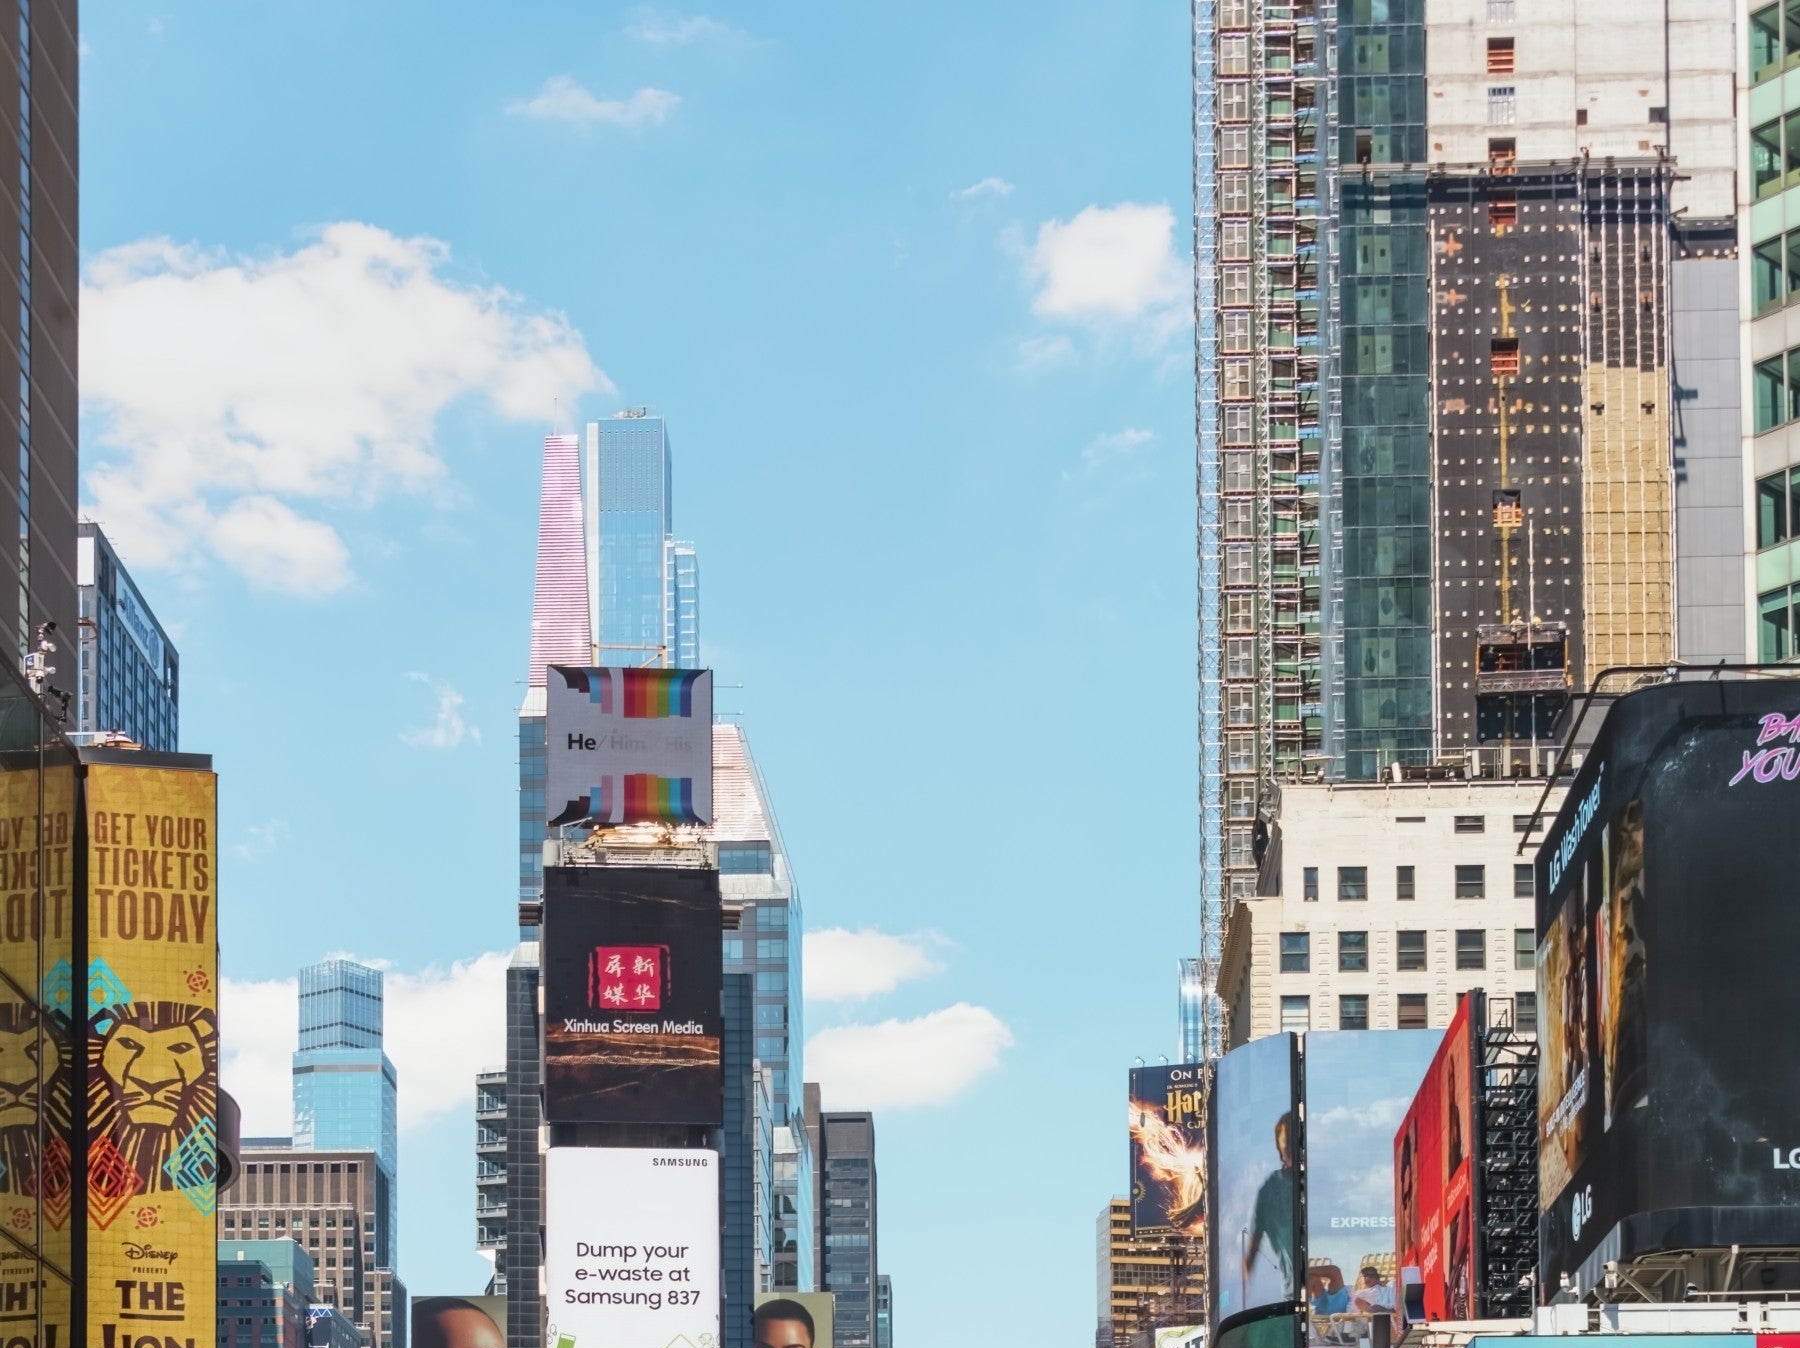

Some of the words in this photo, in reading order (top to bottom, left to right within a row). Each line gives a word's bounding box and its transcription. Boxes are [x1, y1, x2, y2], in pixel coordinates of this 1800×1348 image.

[94, 811, 136, 845] GET
[145, 815, 208, 850] YOUR
[94, 846, 210, 892] TICKETS
[1549, 849, 1561, 895] LG
[94, 888, 210, 944] TODAY
[563, 1018, 609, 1033] Xinhua
[613, 1019, 659, 1034] Screen
[662, 1020, 704, 1034] Media
[1170, 1069, 1192, 1081] ON
[652, 1158, 708, 1167] SAMSUNG
[1581, 1184, 1592, 1225] LG
[1330, 1216, 1396, 1228] EXPRESS
[122, 1242, 178, 1265] Disney
[576, 1242, 637, 1263] Dump
[642, 1245, 689, 1263] your
[133, 1266, 168, 1275] PRESENTS
[575, 1266, 663, 1282] e-waste
[668, 1266, 691, 1282] at
[115, 1280, 185, 1311] THE
[565, 1289, 662, 1310] Samsung
[667, 1290, 700, 1305] 837
